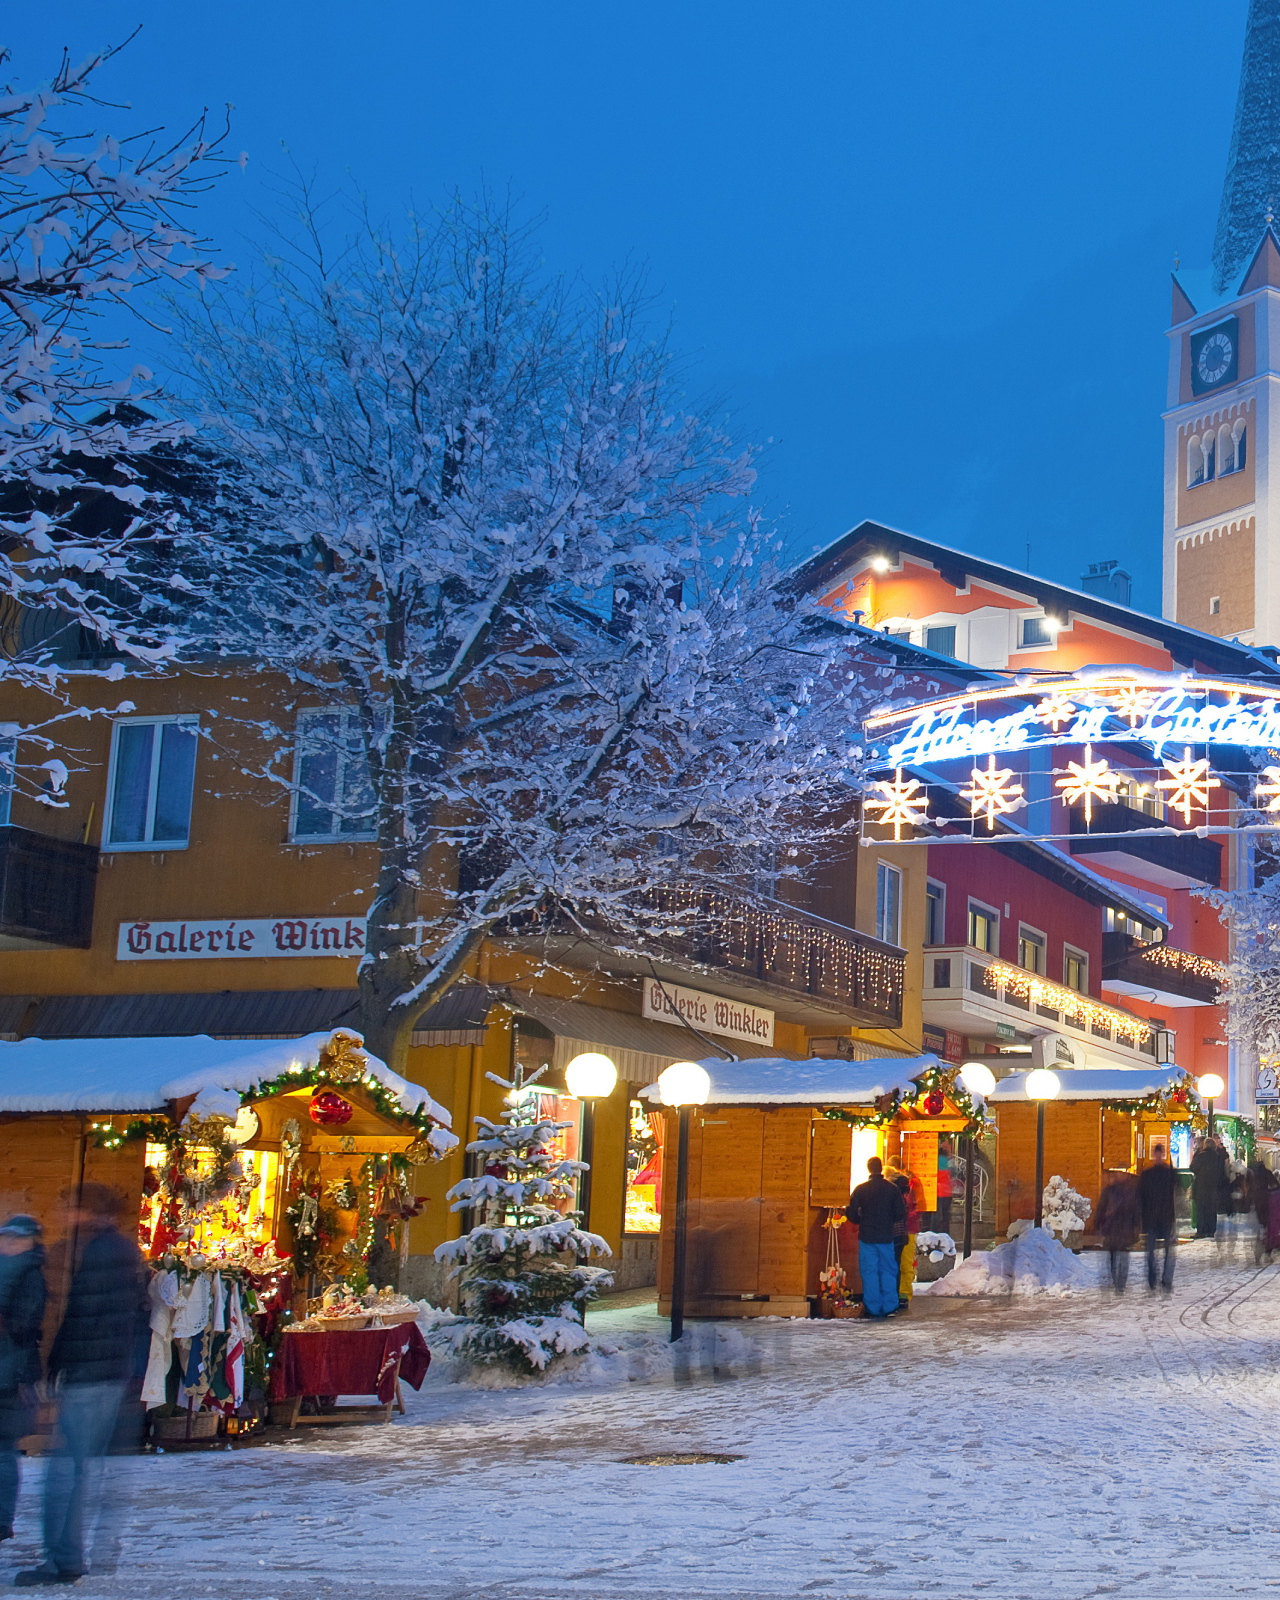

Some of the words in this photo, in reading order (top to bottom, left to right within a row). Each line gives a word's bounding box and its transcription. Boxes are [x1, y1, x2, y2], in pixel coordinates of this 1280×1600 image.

[127, 922, 255, 954] Galerie
[272, 920, 365, 951] Wink
[651, 983, 707, 1023] Galerie
[714, 1001, 769, 1038] Winkler
